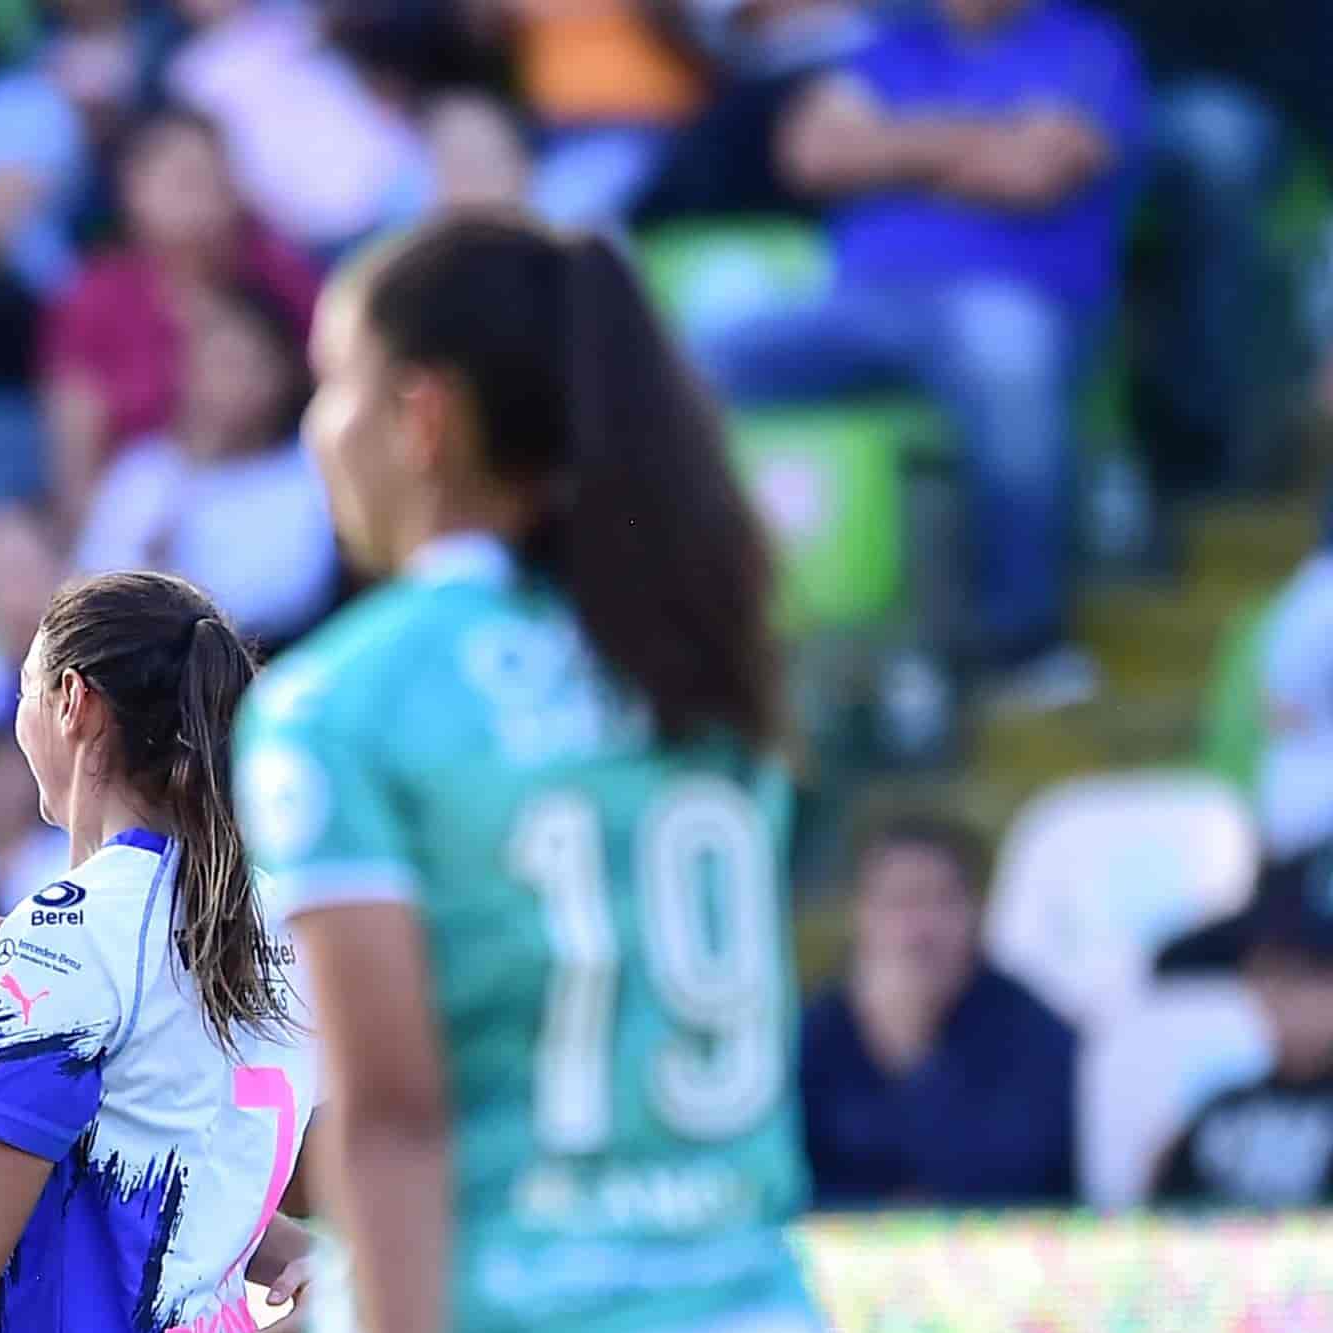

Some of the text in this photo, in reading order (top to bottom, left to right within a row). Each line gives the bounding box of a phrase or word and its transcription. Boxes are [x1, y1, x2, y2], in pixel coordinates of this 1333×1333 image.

[31, 909, 84, 926] Berel
[500, 774, 787, 1154] 19
[219, 1065, 295, 1288] 7
